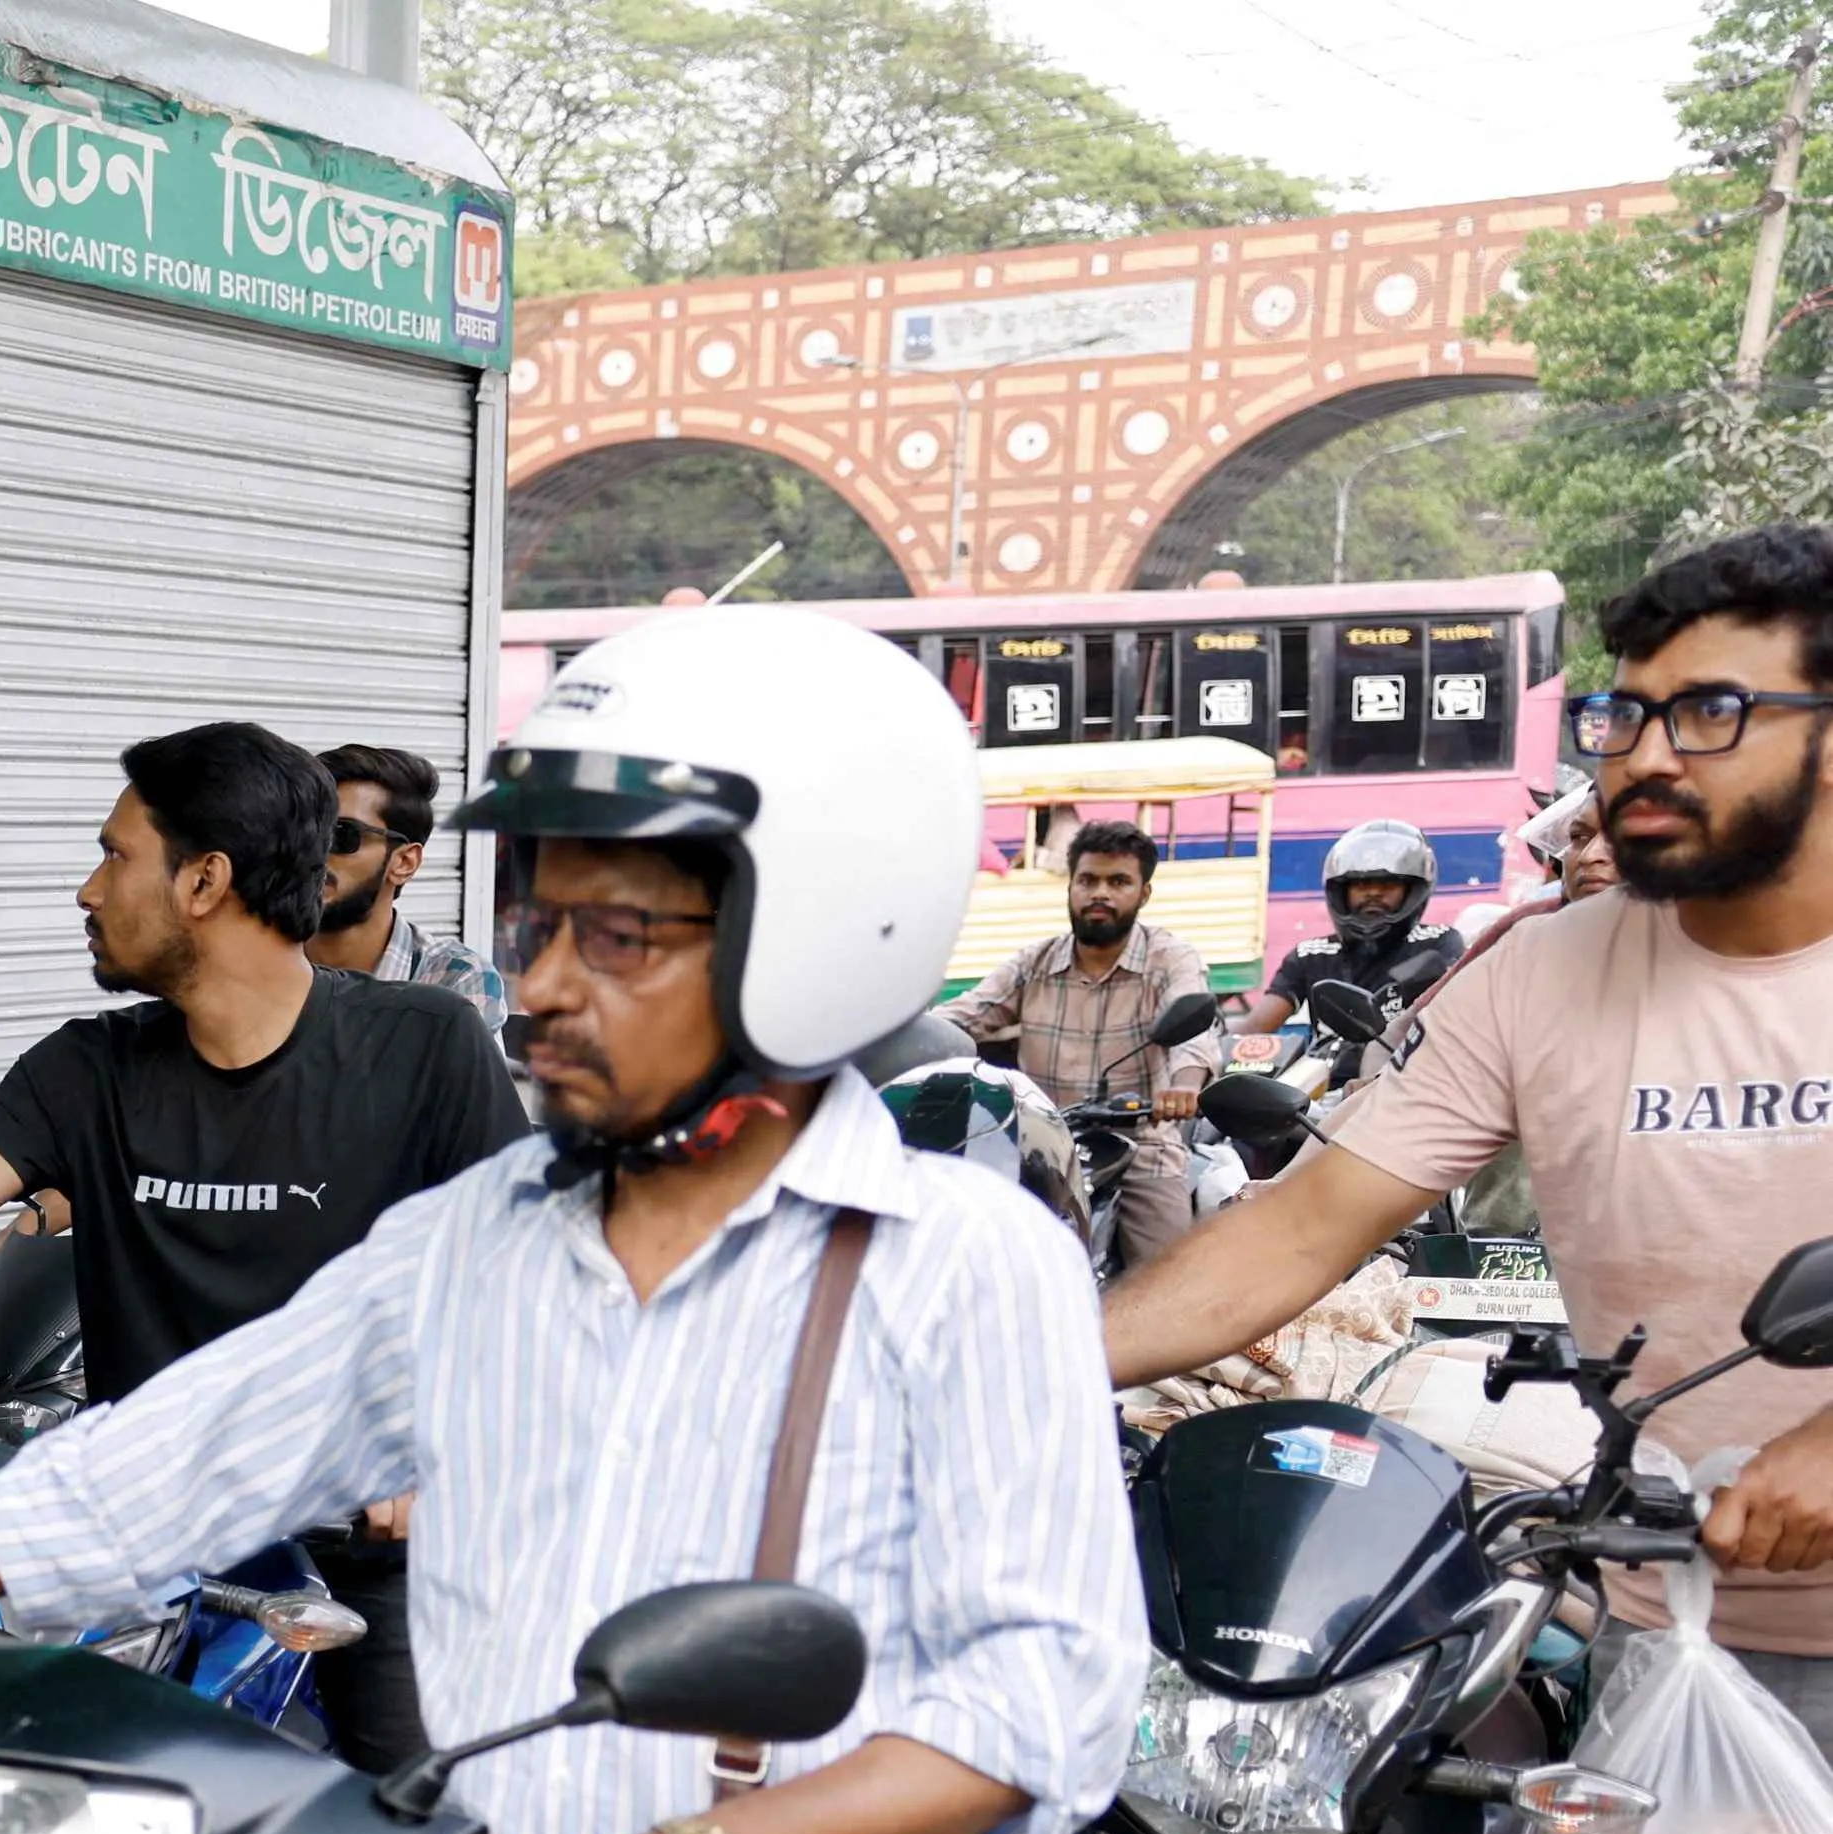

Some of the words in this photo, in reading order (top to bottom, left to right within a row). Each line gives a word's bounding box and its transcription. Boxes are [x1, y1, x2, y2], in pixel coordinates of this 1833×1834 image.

[210, 125, 447, 304] ডিজেল
[144, 252, 211, 295] FROM
[219, 274, 306, 318] BRITISH
[311, 292, 442, 344] PETROLEUM
[455, 311, 498, 344] মেঘনা
[1627, 1078, 1833, 1135] BARG
[134, 1175, 278, 1211] PUMA
[1484, 1244, 1542, 1255] SUZUKI
[1476, 1302, 1505, 1316] BURN
[1507, 1304, 1533, 1317] UNIT
[1213, 1624, 1314, 1655] HONDA
